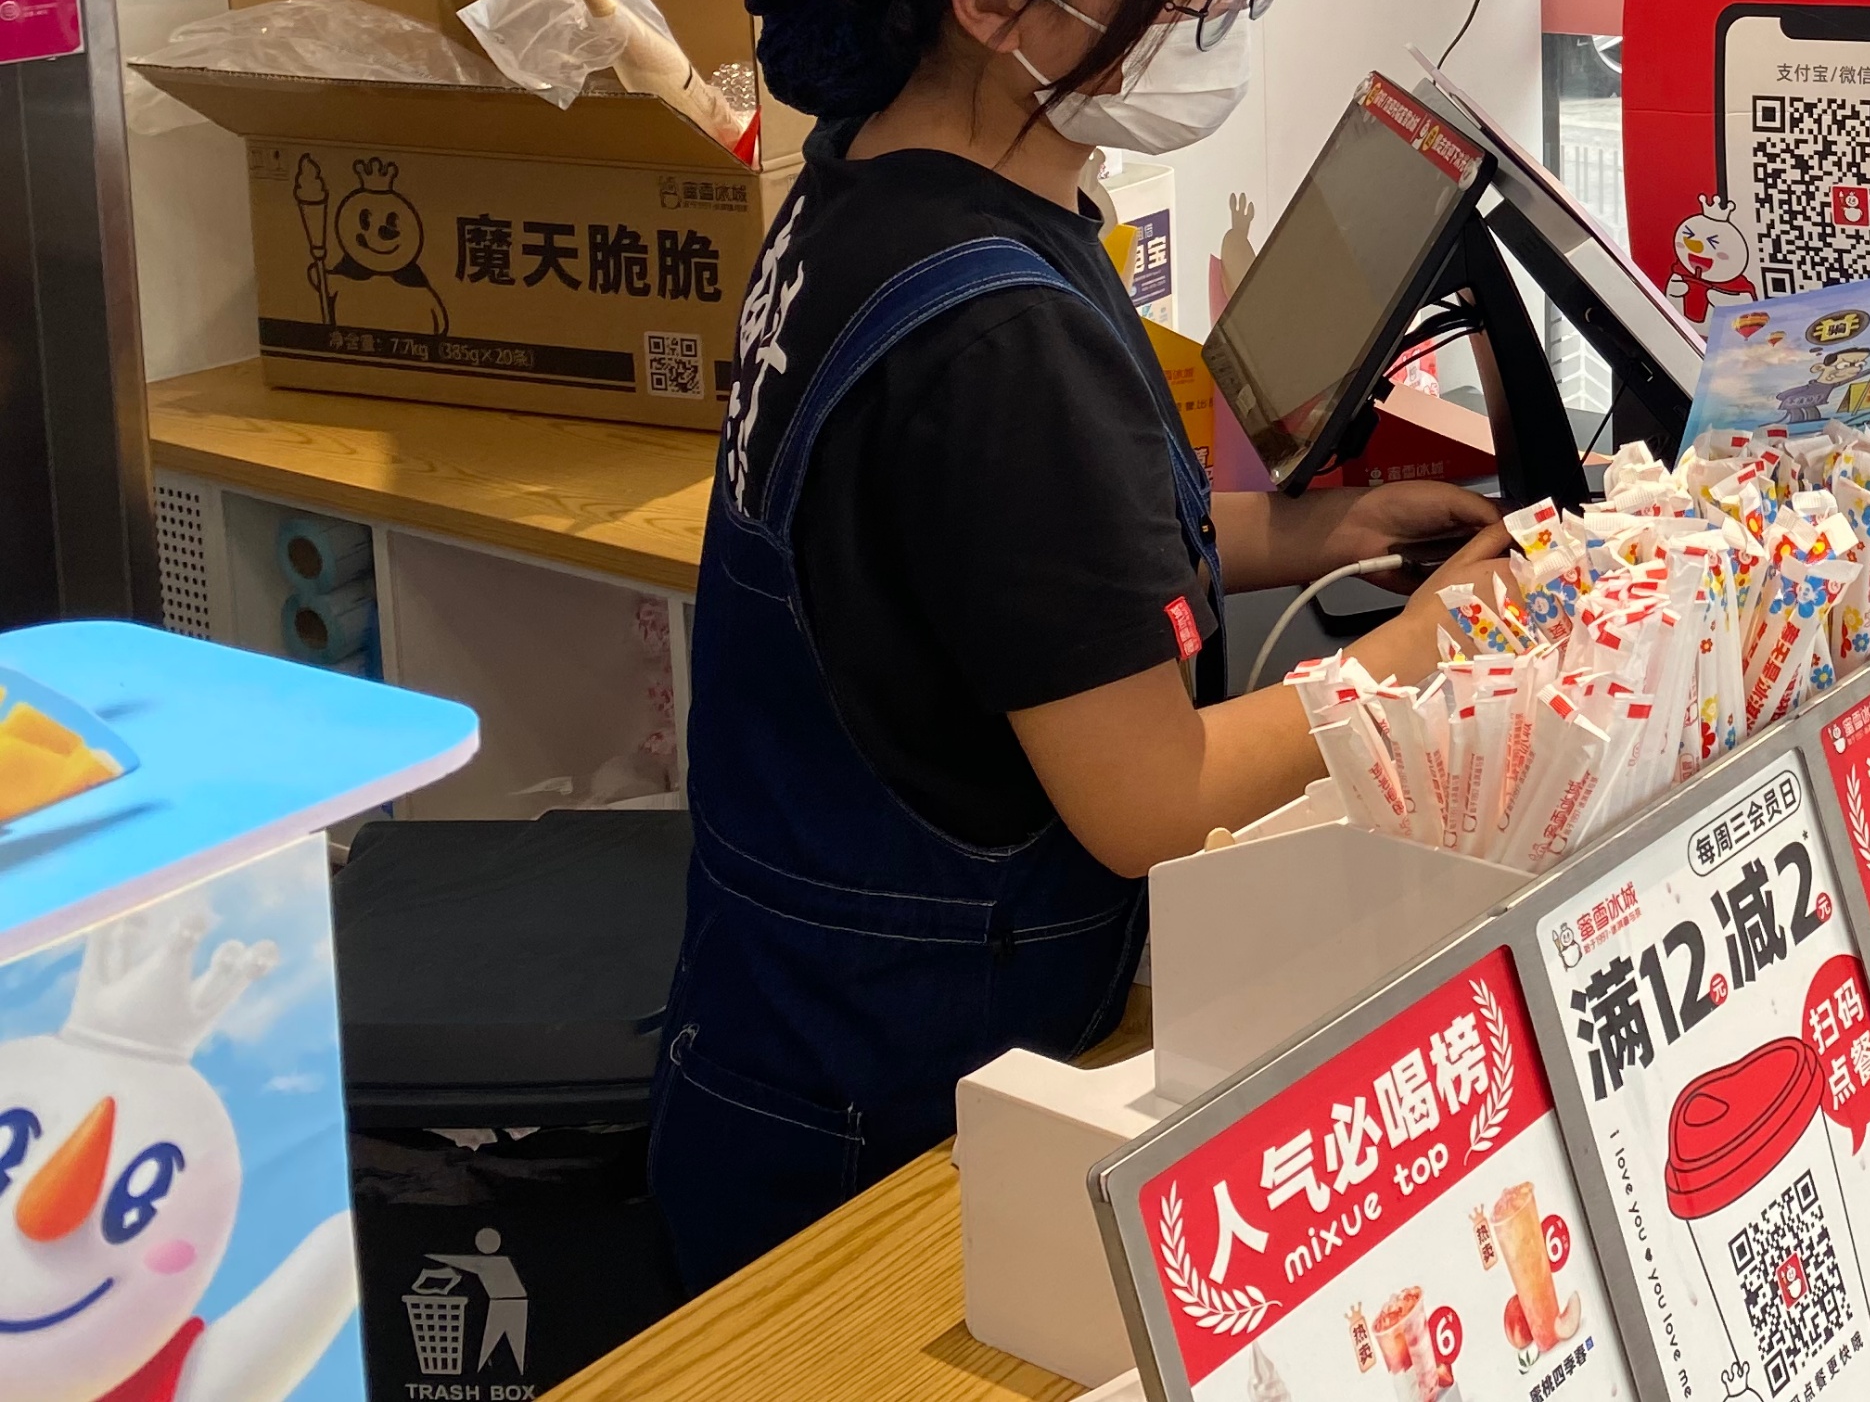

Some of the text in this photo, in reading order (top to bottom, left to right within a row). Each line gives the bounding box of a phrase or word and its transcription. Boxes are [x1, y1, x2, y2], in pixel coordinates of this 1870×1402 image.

[455, 213, 723, 302] 魔天脆脆
[1695, 779, 1797, 867] 每周三会员日
[1577, 883, 1640, 942] 蜜雪冰城
[1807, 976, 1866, 1058] 扫码
[1208, 1011, 1491, 1285] 人气必喝榜
[1284, 1141, 1450, 1285] mixue top
[1475, 1224, 1497, 1265] 热卖
[1615, 1147, 1634, 1196] love
[1628, 1200, 1648, 1241] you
[1647, 1267, 1667, 1310] you
[1662, 1312, 1682, 1362] love
[1677, 1368, 1693, 1399] me
[1352, 1324, 1374, 1367] 热卖
[406, 1383, 535, 1401] TRASH BOX
